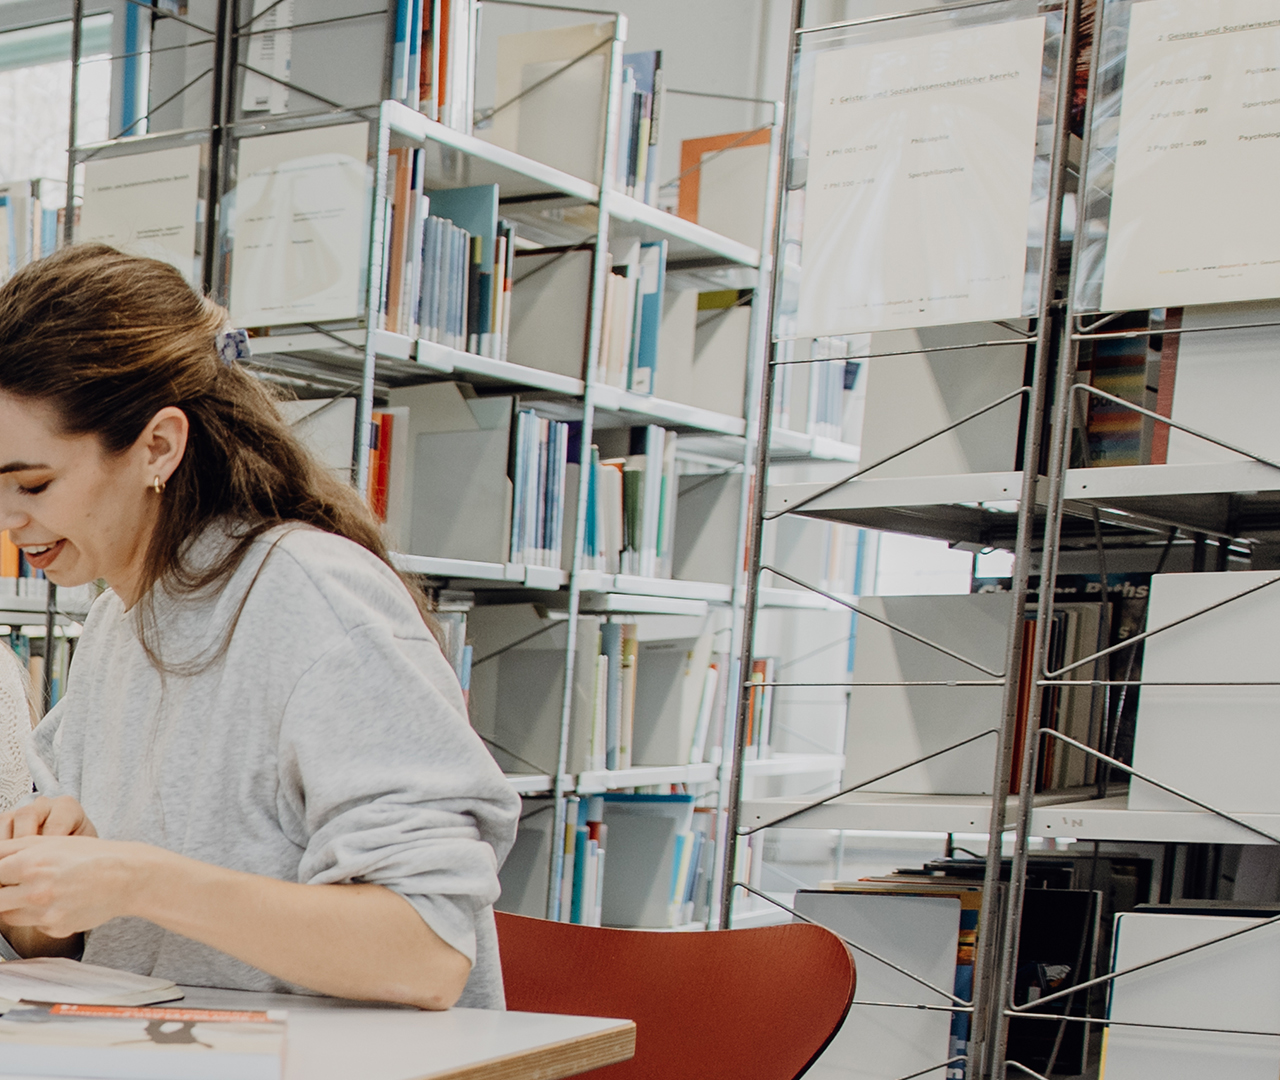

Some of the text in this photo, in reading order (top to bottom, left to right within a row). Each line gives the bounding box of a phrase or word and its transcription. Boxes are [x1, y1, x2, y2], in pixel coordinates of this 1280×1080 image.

[1204, 27, 1221, 36] und
[989, 70, 1020, 81] Bereich
[911, 133, 950, 145] Philosophie
